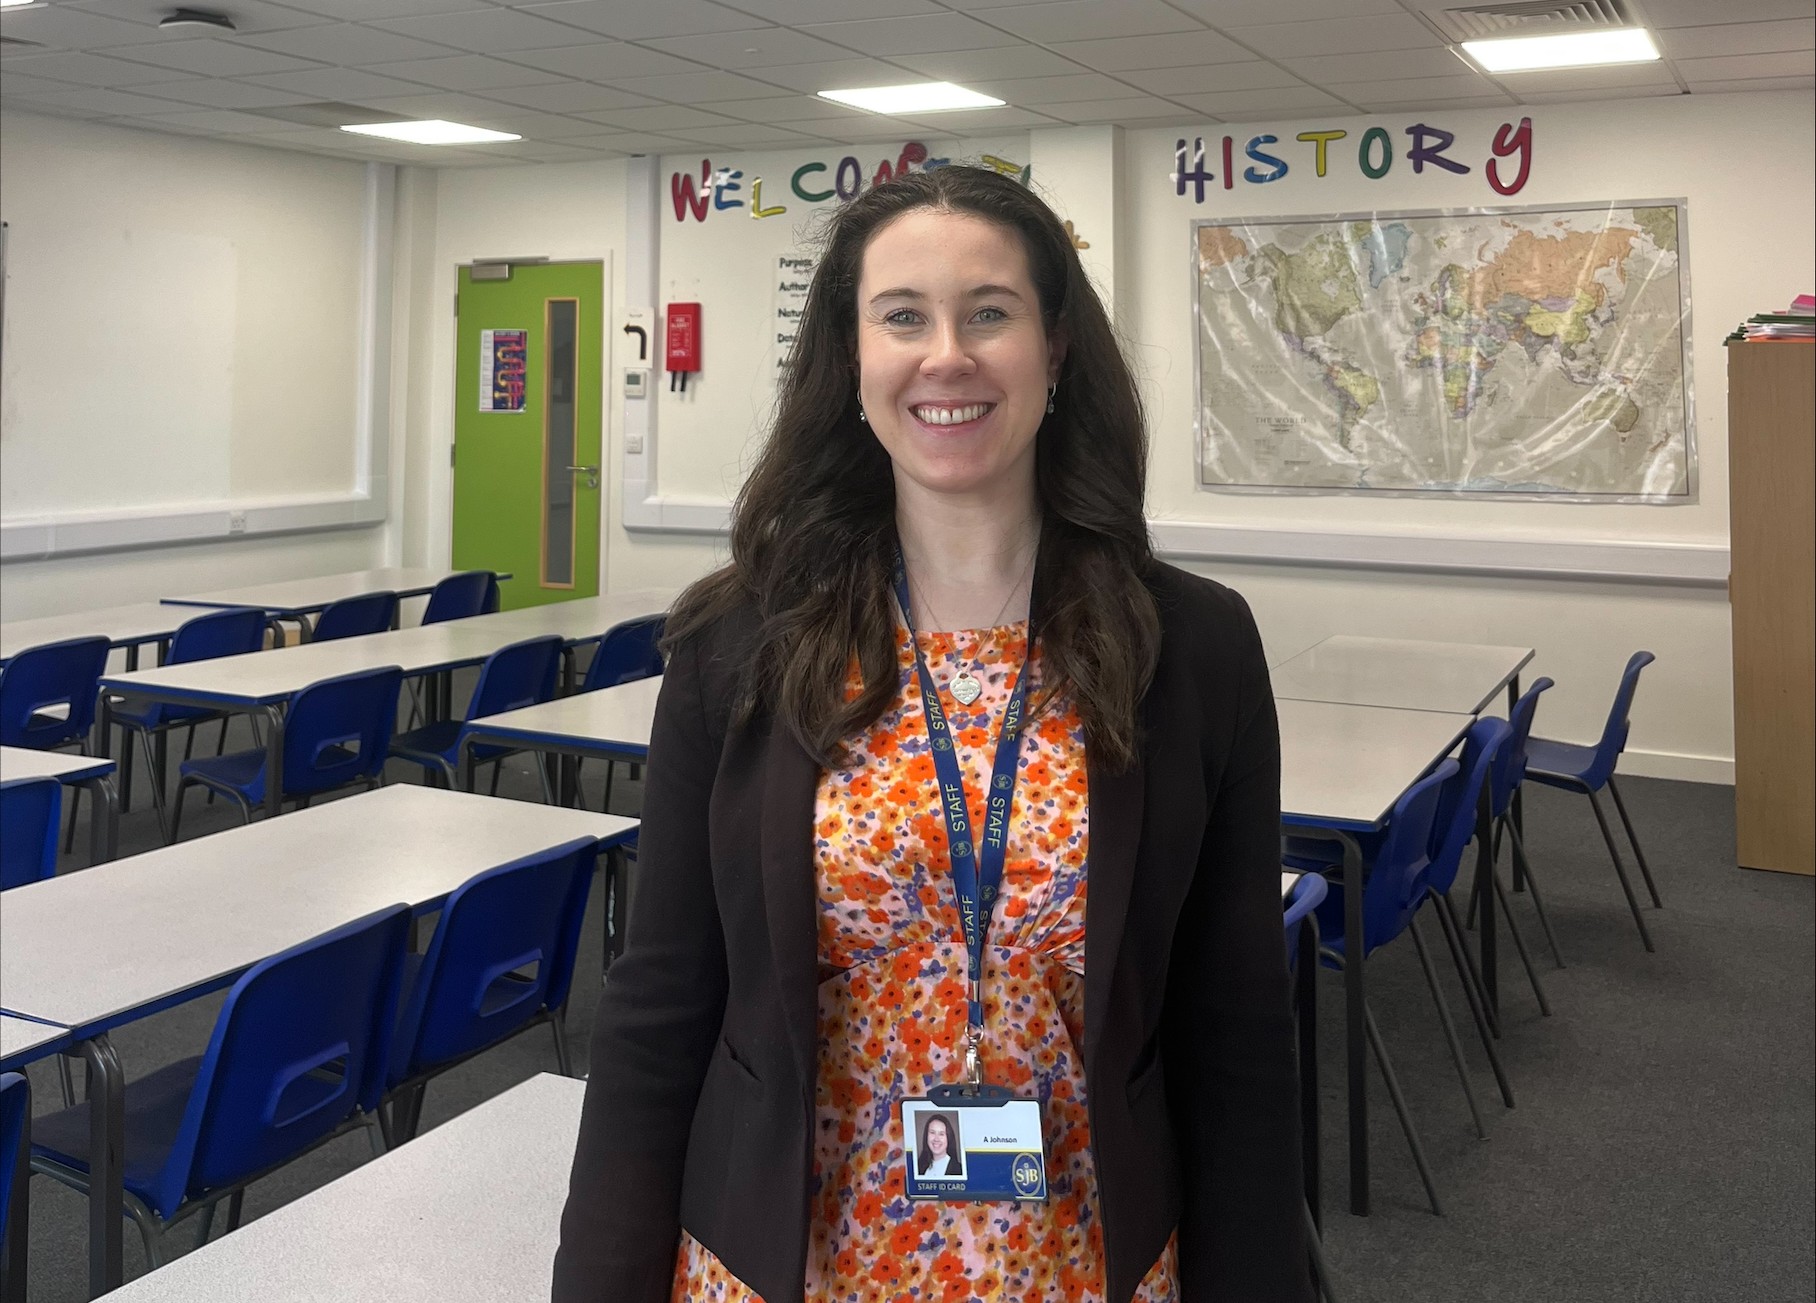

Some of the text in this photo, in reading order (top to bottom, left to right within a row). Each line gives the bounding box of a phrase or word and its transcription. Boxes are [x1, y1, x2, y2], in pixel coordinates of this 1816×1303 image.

[1170, 117, 1532, 204] HISTORY
[925, 689, 945, 730] STAFF
[945, 783, 966, 832] STAFF
[987, 796, 1006, 849] STAFF
[961, 894, 975, 946] STAFF
[990, 1136, 1018, 1144] Johnson
[917, 1183, 966, 1191] STAFF ID CARD
